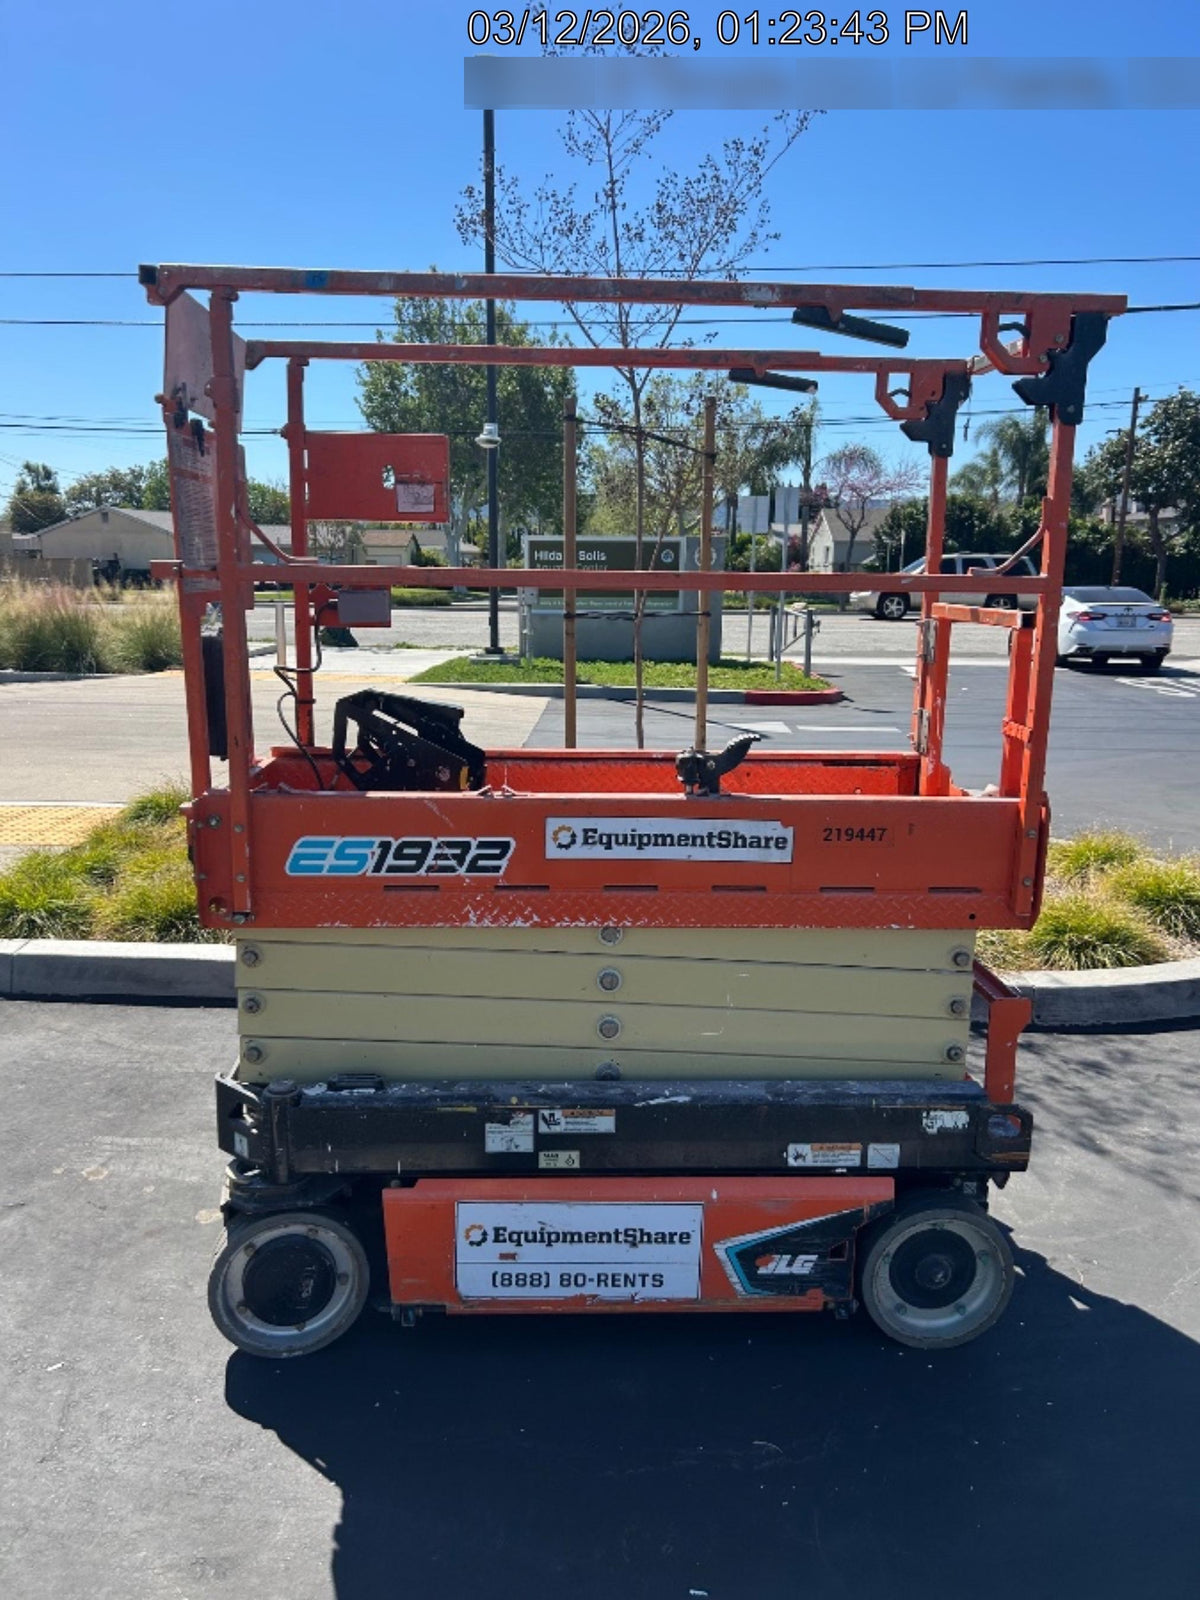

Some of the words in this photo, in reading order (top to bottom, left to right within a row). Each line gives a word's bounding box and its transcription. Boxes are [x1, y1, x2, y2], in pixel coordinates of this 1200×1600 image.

[578, 550, 607, 561] Solis
[581, 828, 788, 851] EquipmentShare
[822, 827, 888, 842] 219447
[285, 836, 516, 876] ES1932
[492, 1226, 692, 1247] EquipmentShare
[757, 1254, 818, 1274] JLG
[491, 1271, 551, 1288] (888)
[559, 1271, 665, 1289] 80-RENTS
